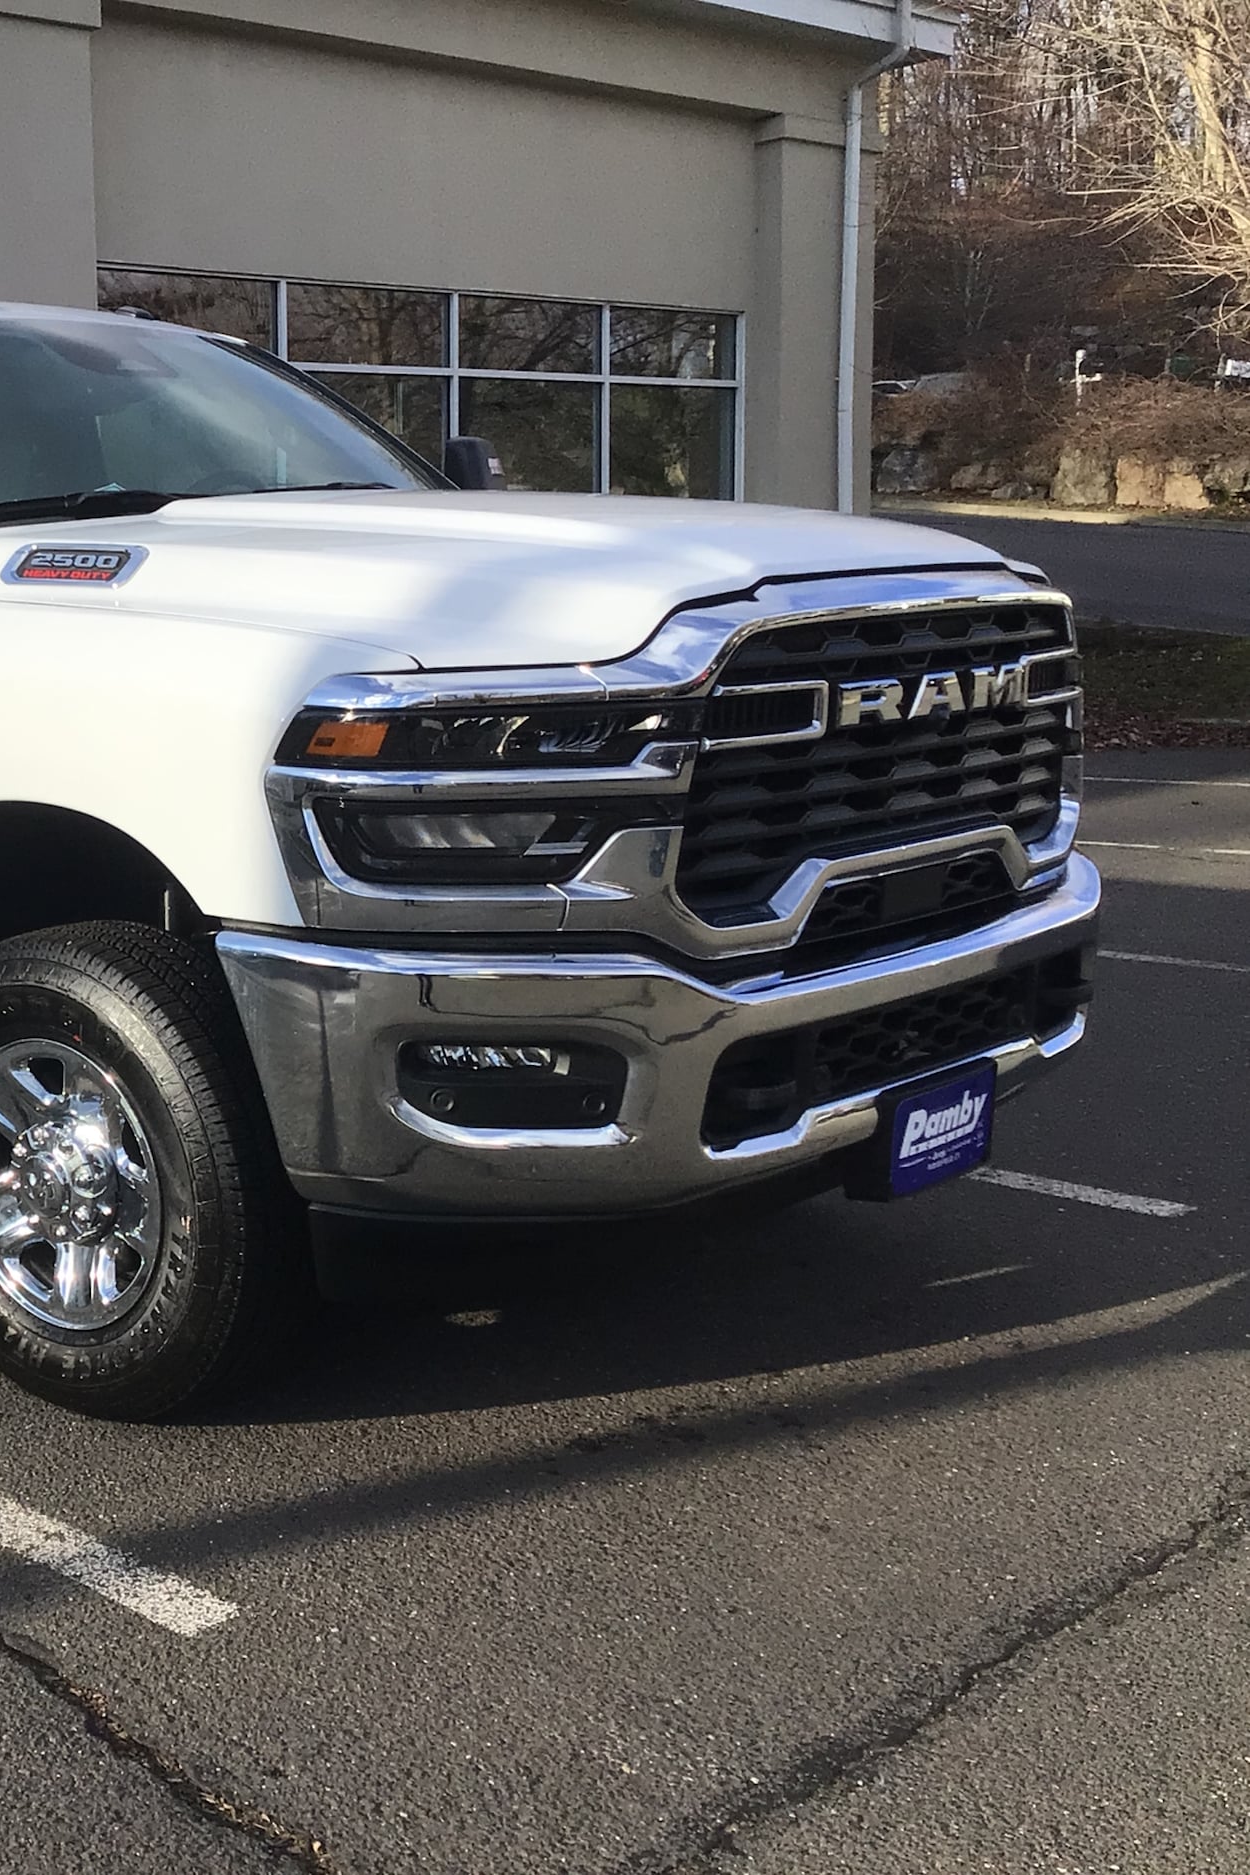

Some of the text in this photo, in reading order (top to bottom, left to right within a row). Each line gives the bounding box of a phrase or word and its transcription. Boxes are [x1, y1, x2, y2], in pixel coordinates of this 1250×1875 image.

[23, 569, 112, 580] HEAVY DUTY
[31, 553, 121, 568] 2500
[839, 664, 1025, 727] RAM
[899, 1090, 988, 1159] Pamby
